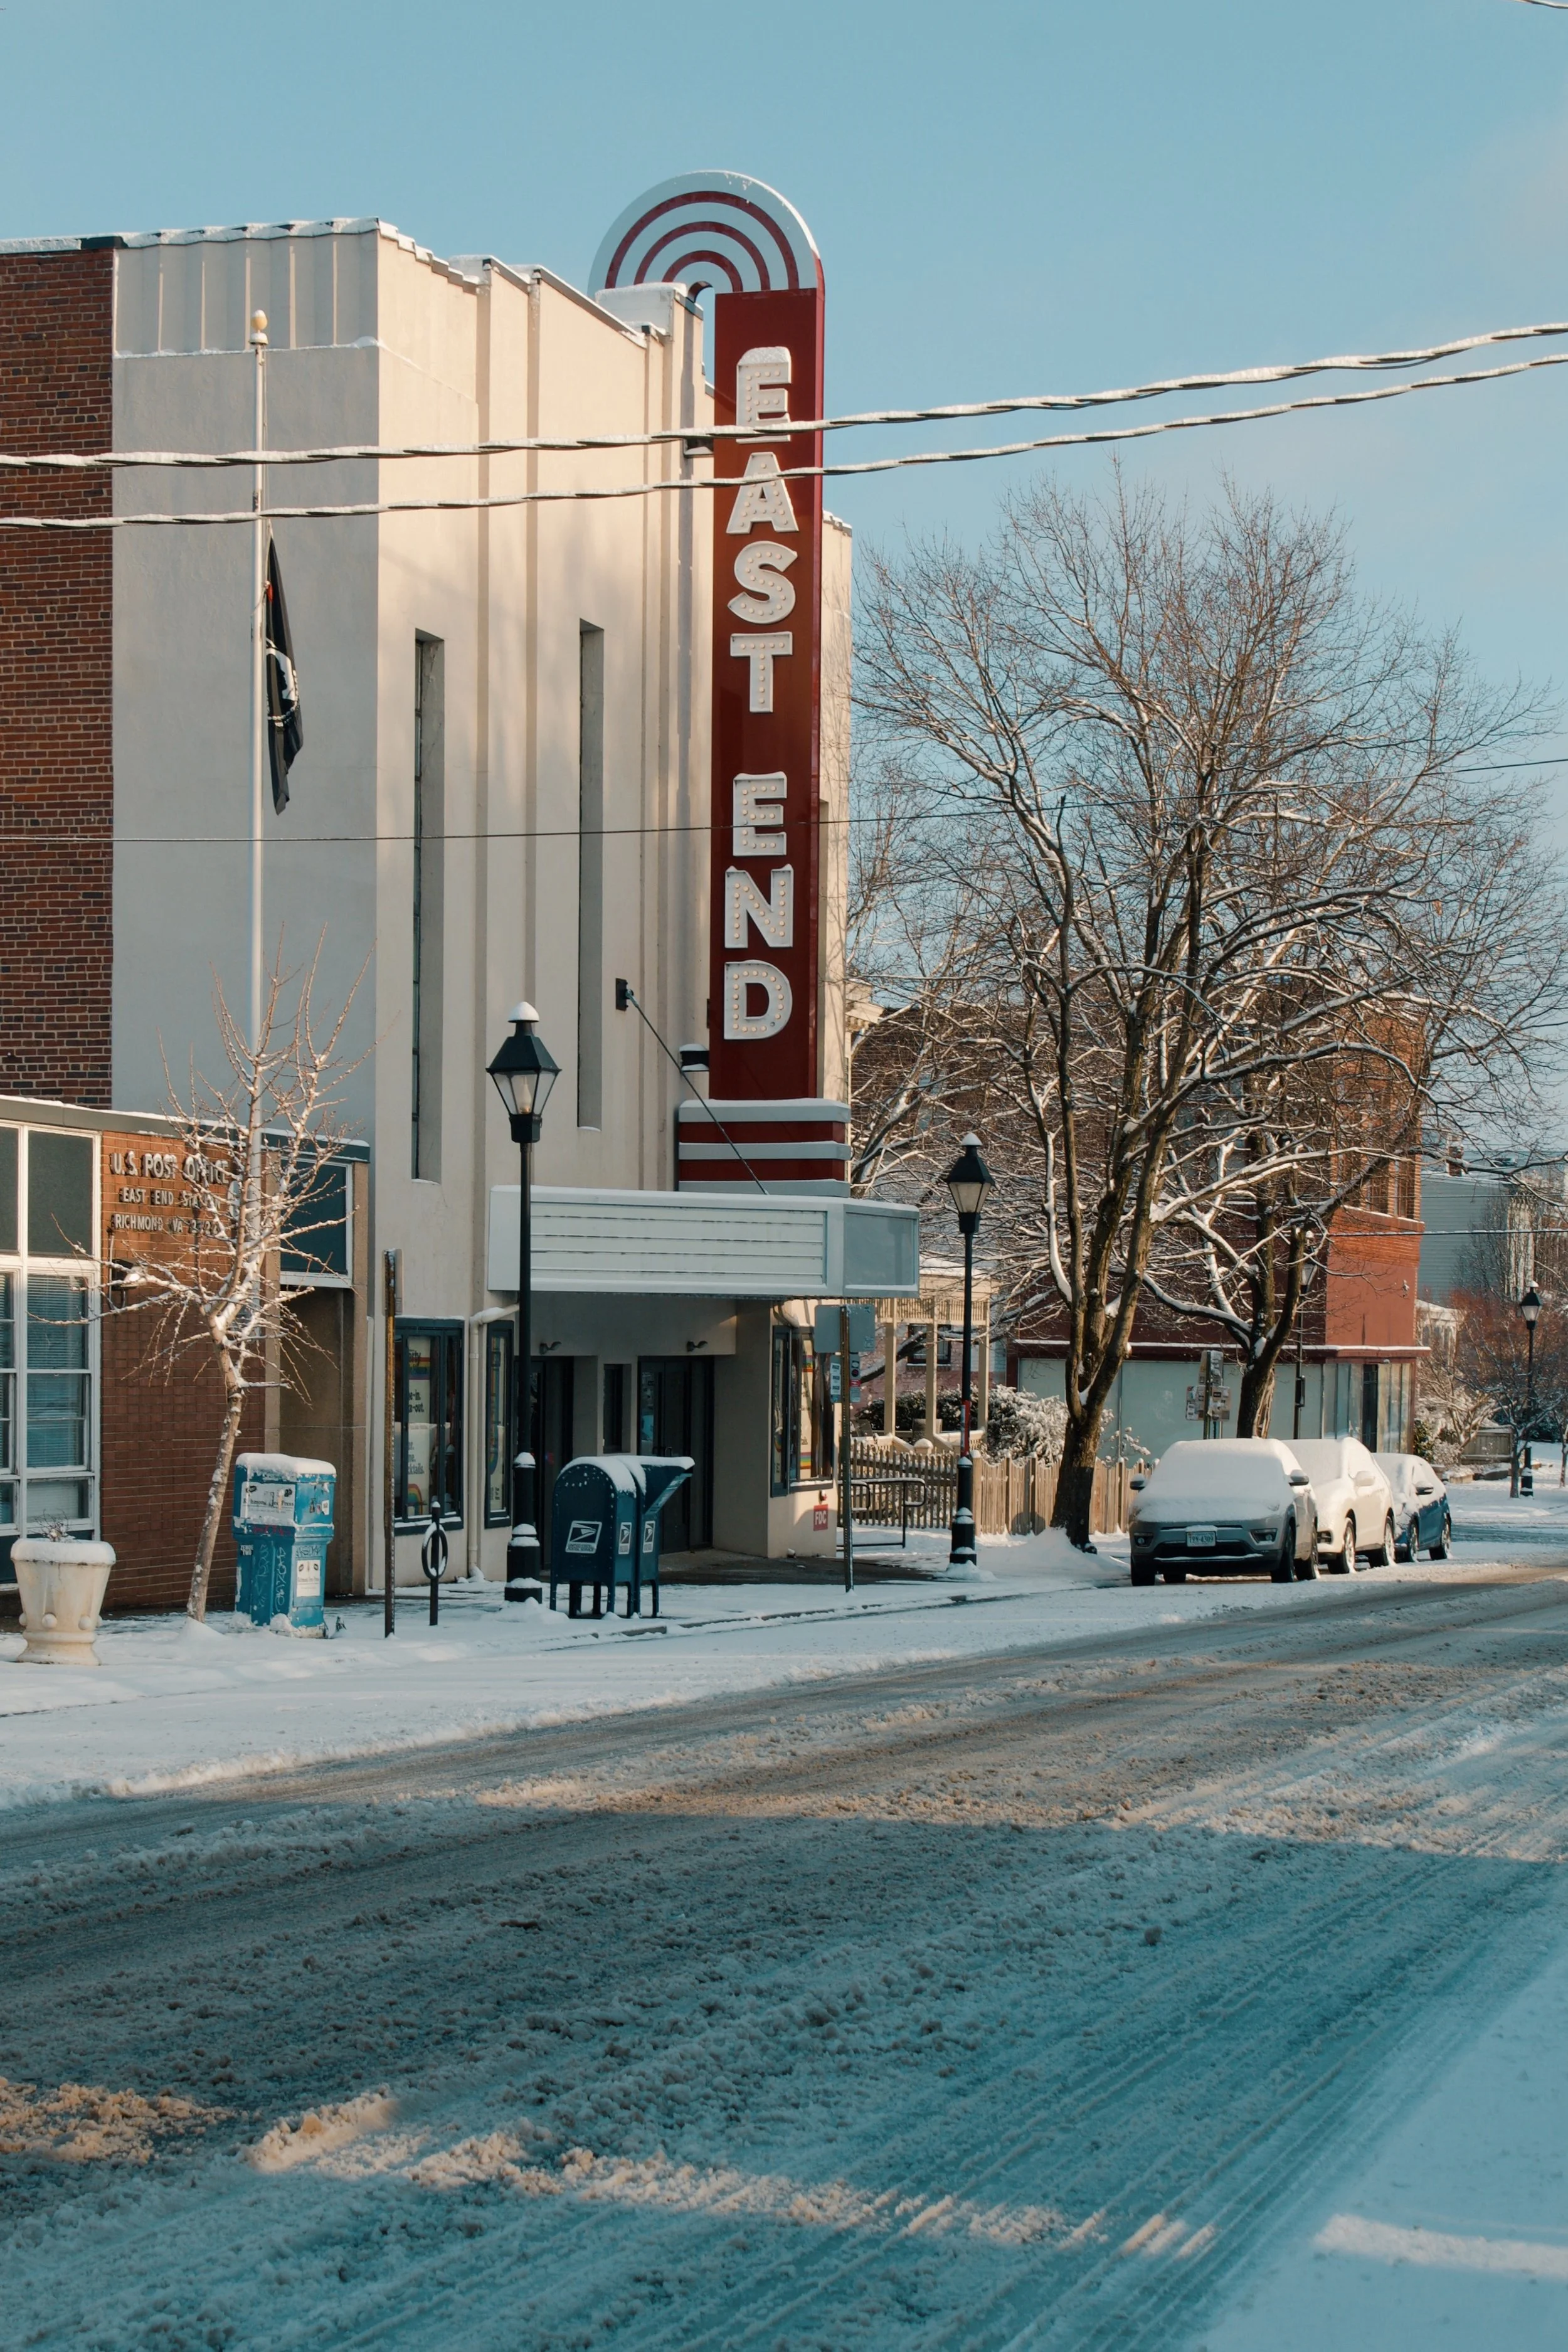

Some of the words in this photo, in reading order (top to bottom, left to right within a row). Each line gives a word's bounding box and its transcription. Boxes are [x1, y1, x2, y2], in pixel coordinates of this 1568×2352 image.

[726, 347, 799, 713] EAST
[724, 772, 793, 1041] END
[110, 1152, 138, 1176] U.S.
[142, 1153, 177, 1179] POST
[121, 1187, 146, 1203] EAST
[154, 1190, 174, 1205] END
[115, 1214, 163, 1231] RICHMOND
[172, 1217, 183, 1232] VA
[815, 1510, 827, 1525] FDC
